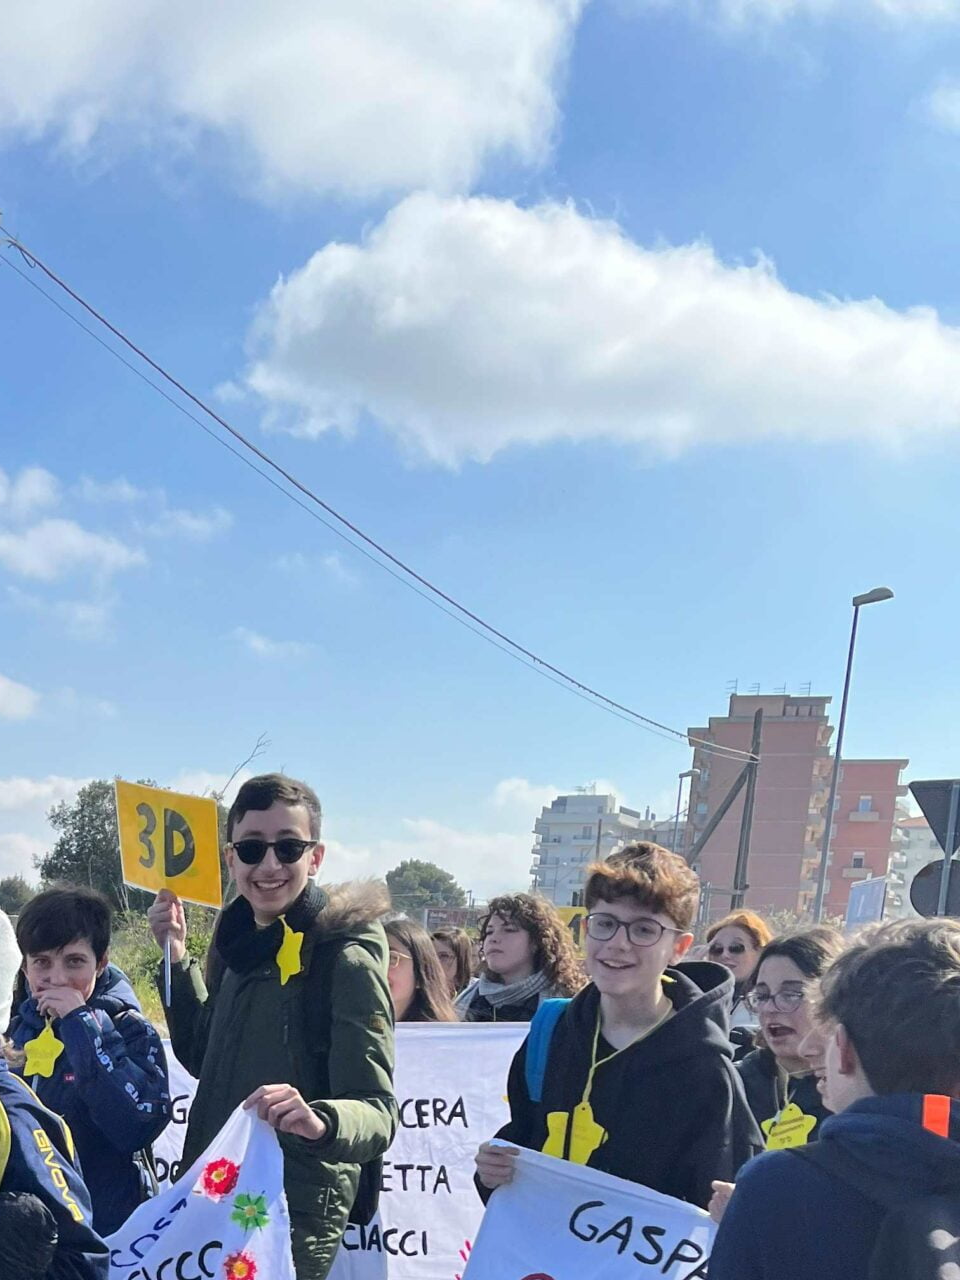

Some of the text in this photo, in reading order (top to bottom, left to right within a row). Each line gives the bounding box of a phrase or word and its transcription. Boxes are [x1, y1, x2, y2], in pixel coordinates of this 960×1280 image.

[136, 802, 195, 878] 3D
[400, 1096, 469, 1129] CERA
[33, 1129, 85, 1222] GIVOVA
[381, 1161, 452, 1194] ETTA
